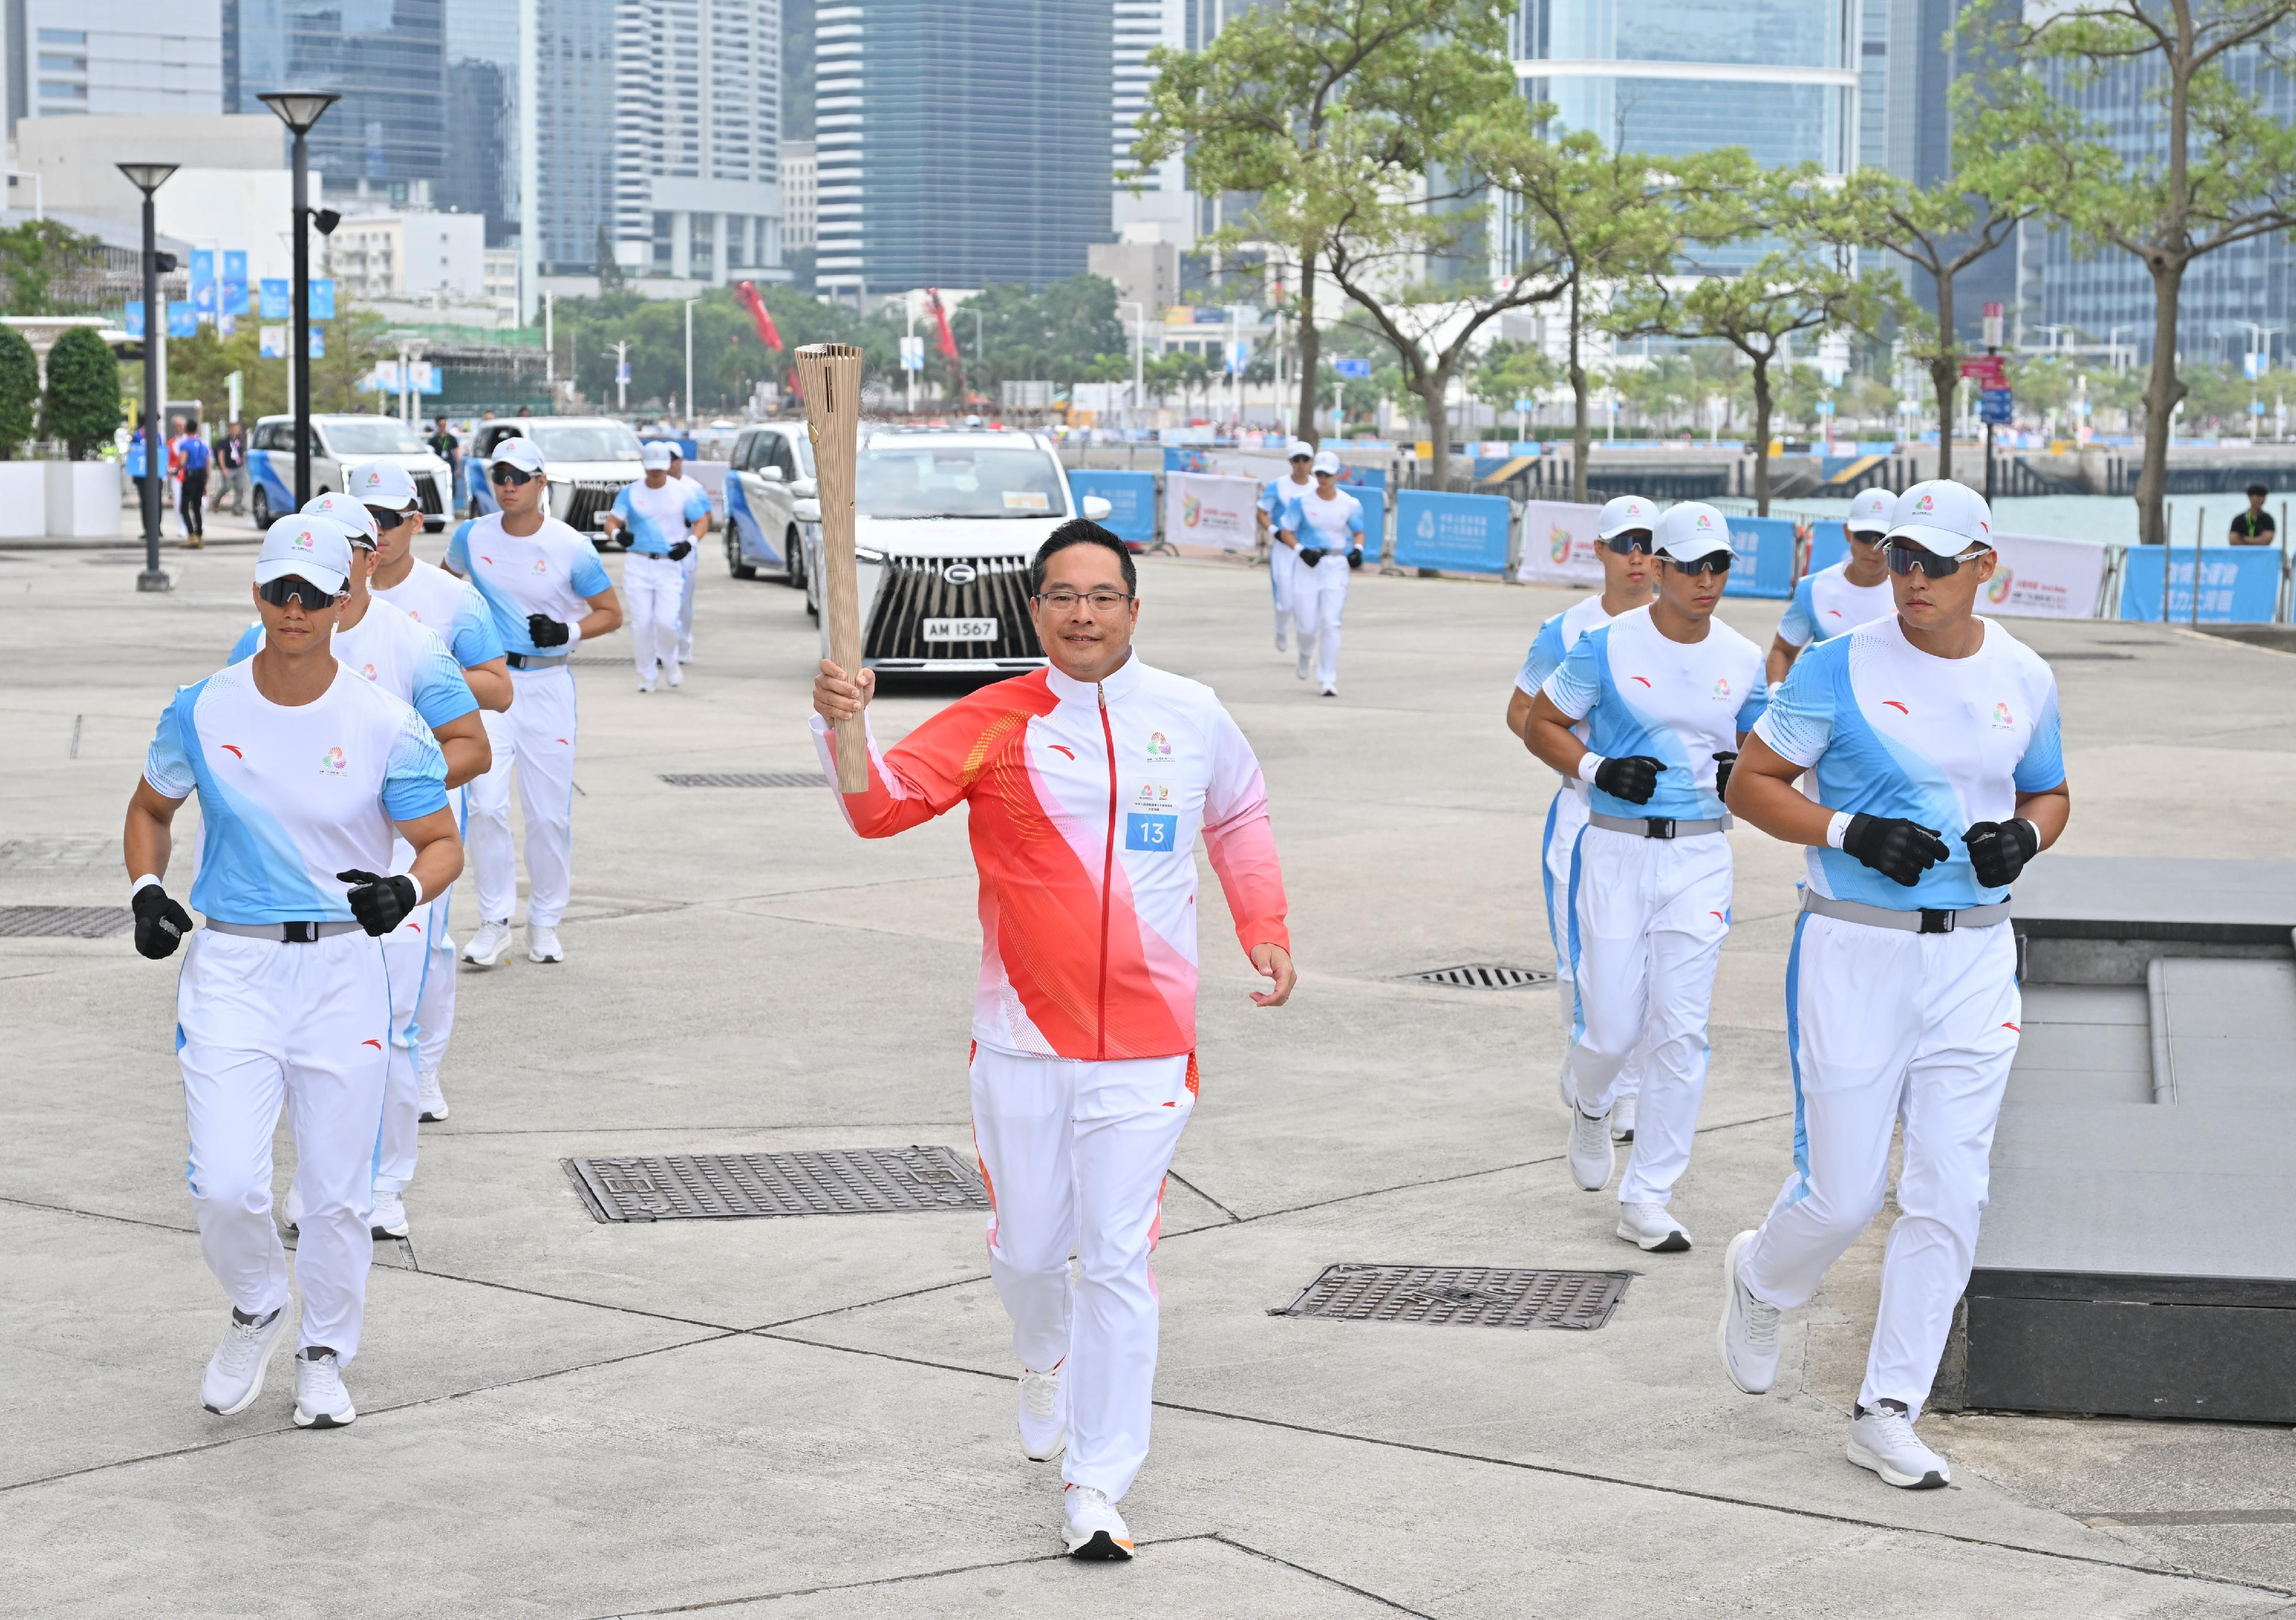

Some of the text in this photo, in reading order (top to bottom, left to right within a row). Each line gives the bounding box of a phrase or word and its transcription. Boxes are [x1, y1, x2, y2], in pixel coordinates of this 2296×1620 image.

[929, 621, 992, 635] AM 1567
[1141, 822, 1164, 844] 13
